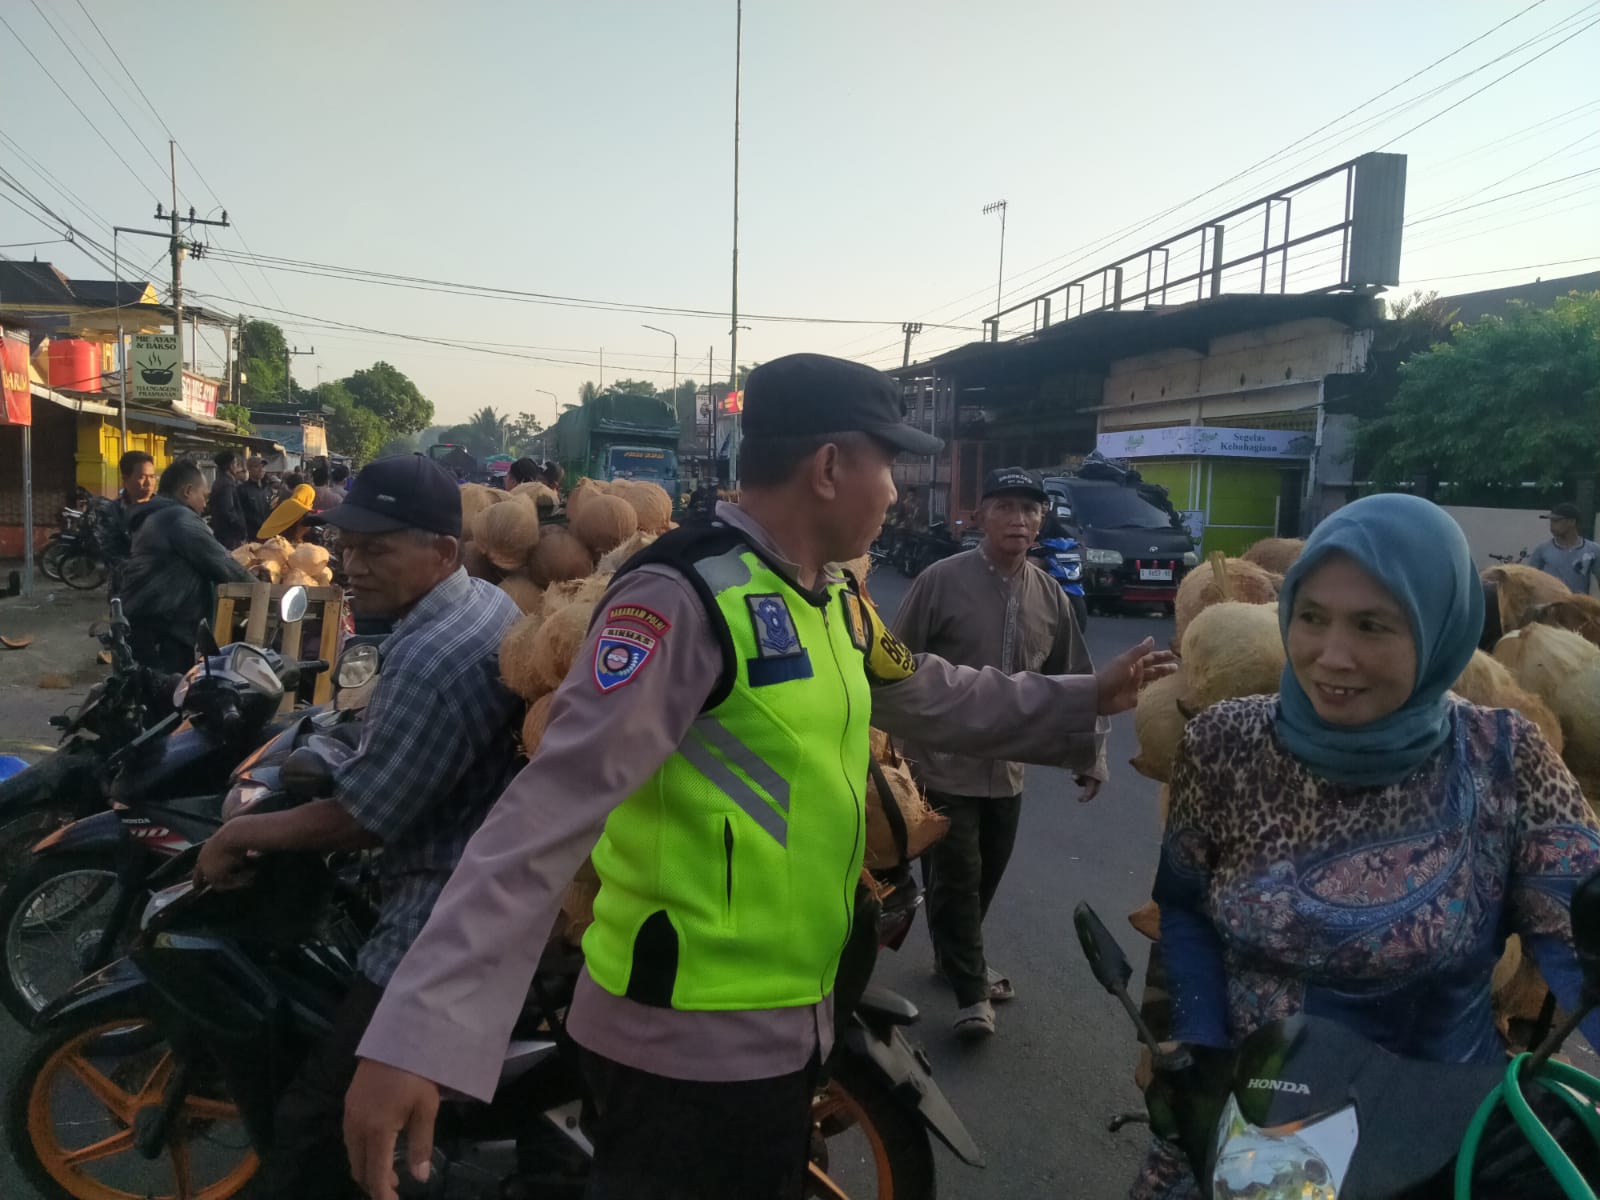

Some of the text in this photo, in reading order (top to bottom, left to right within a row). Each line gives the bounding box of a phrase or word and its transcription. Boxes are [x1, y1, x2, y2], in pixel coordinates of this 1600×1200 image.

[1233, 433, 1266, 443] Segelas
[1220, 442, 1277, 452] Kebahagiaan
[1247, 1078, 1311, 1095] HONDA
